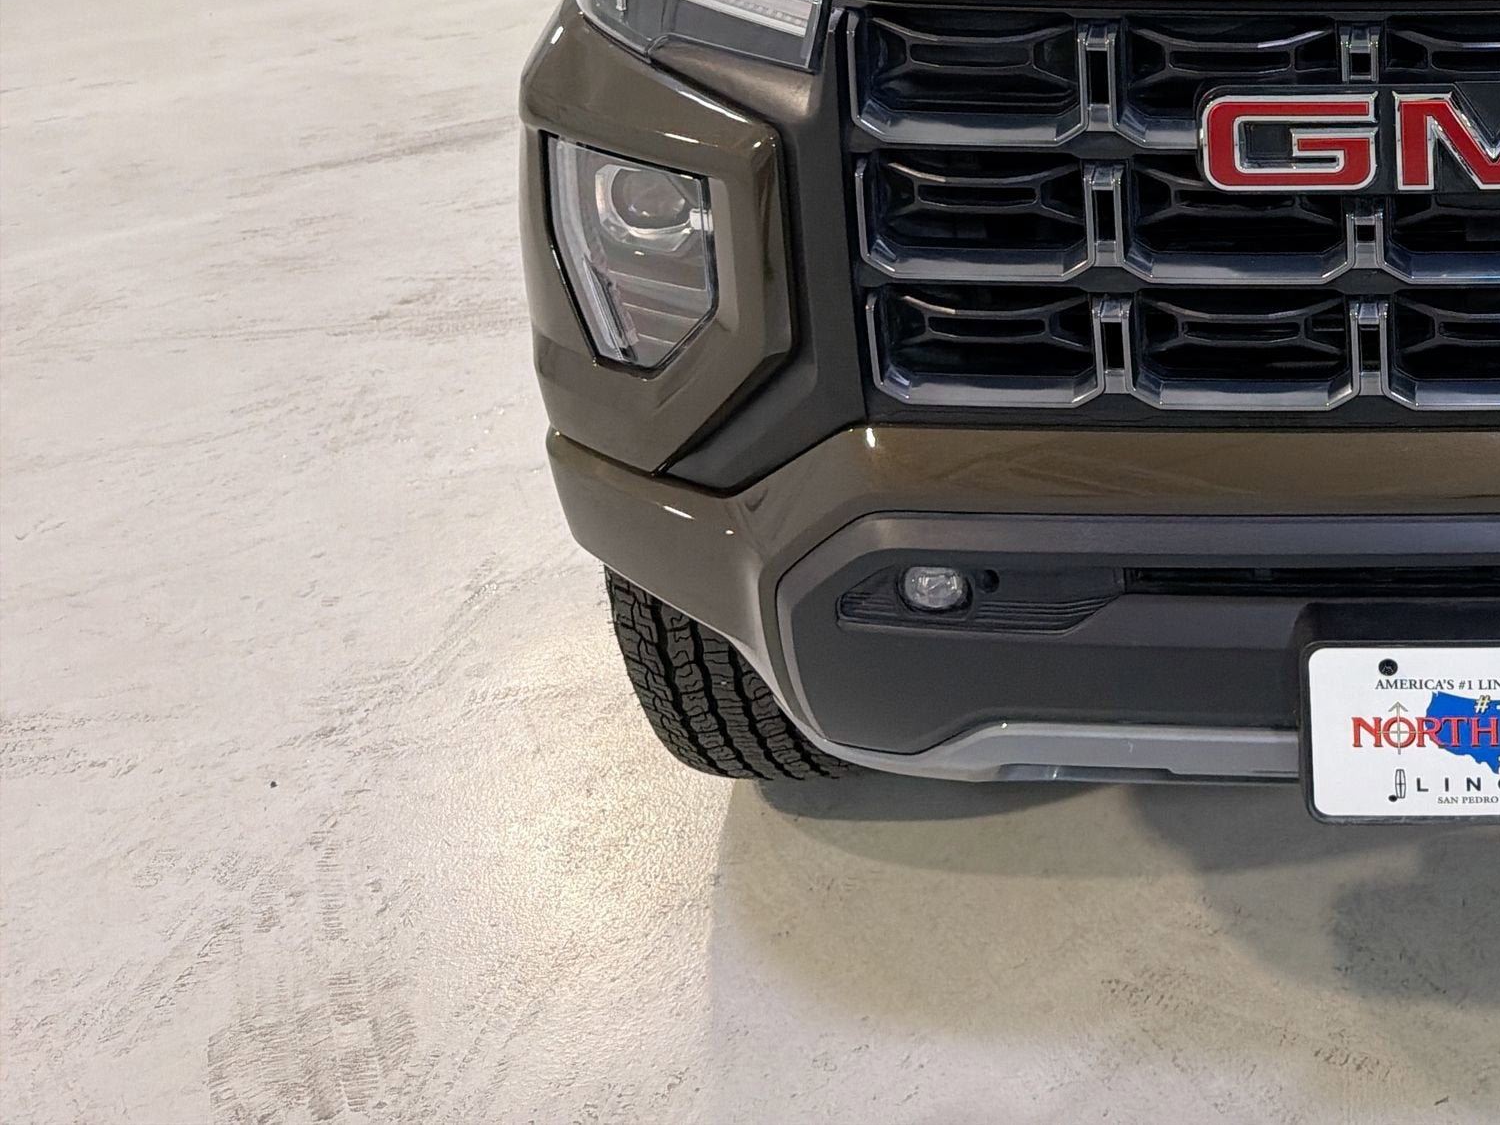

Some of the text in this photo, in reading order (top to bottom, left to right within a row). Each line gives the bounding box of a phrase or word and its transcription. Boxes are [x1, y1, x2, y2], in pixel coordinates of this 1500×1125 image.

[1375, 678, 1455, 691] AMERICA'S
[1459, 679, 1473, 691] #1
[1351, 716, 1499, 749] NORTH
[1437, 792, 1459, 805] SAN
[1462, 791, 1499, 804] PEDRO
